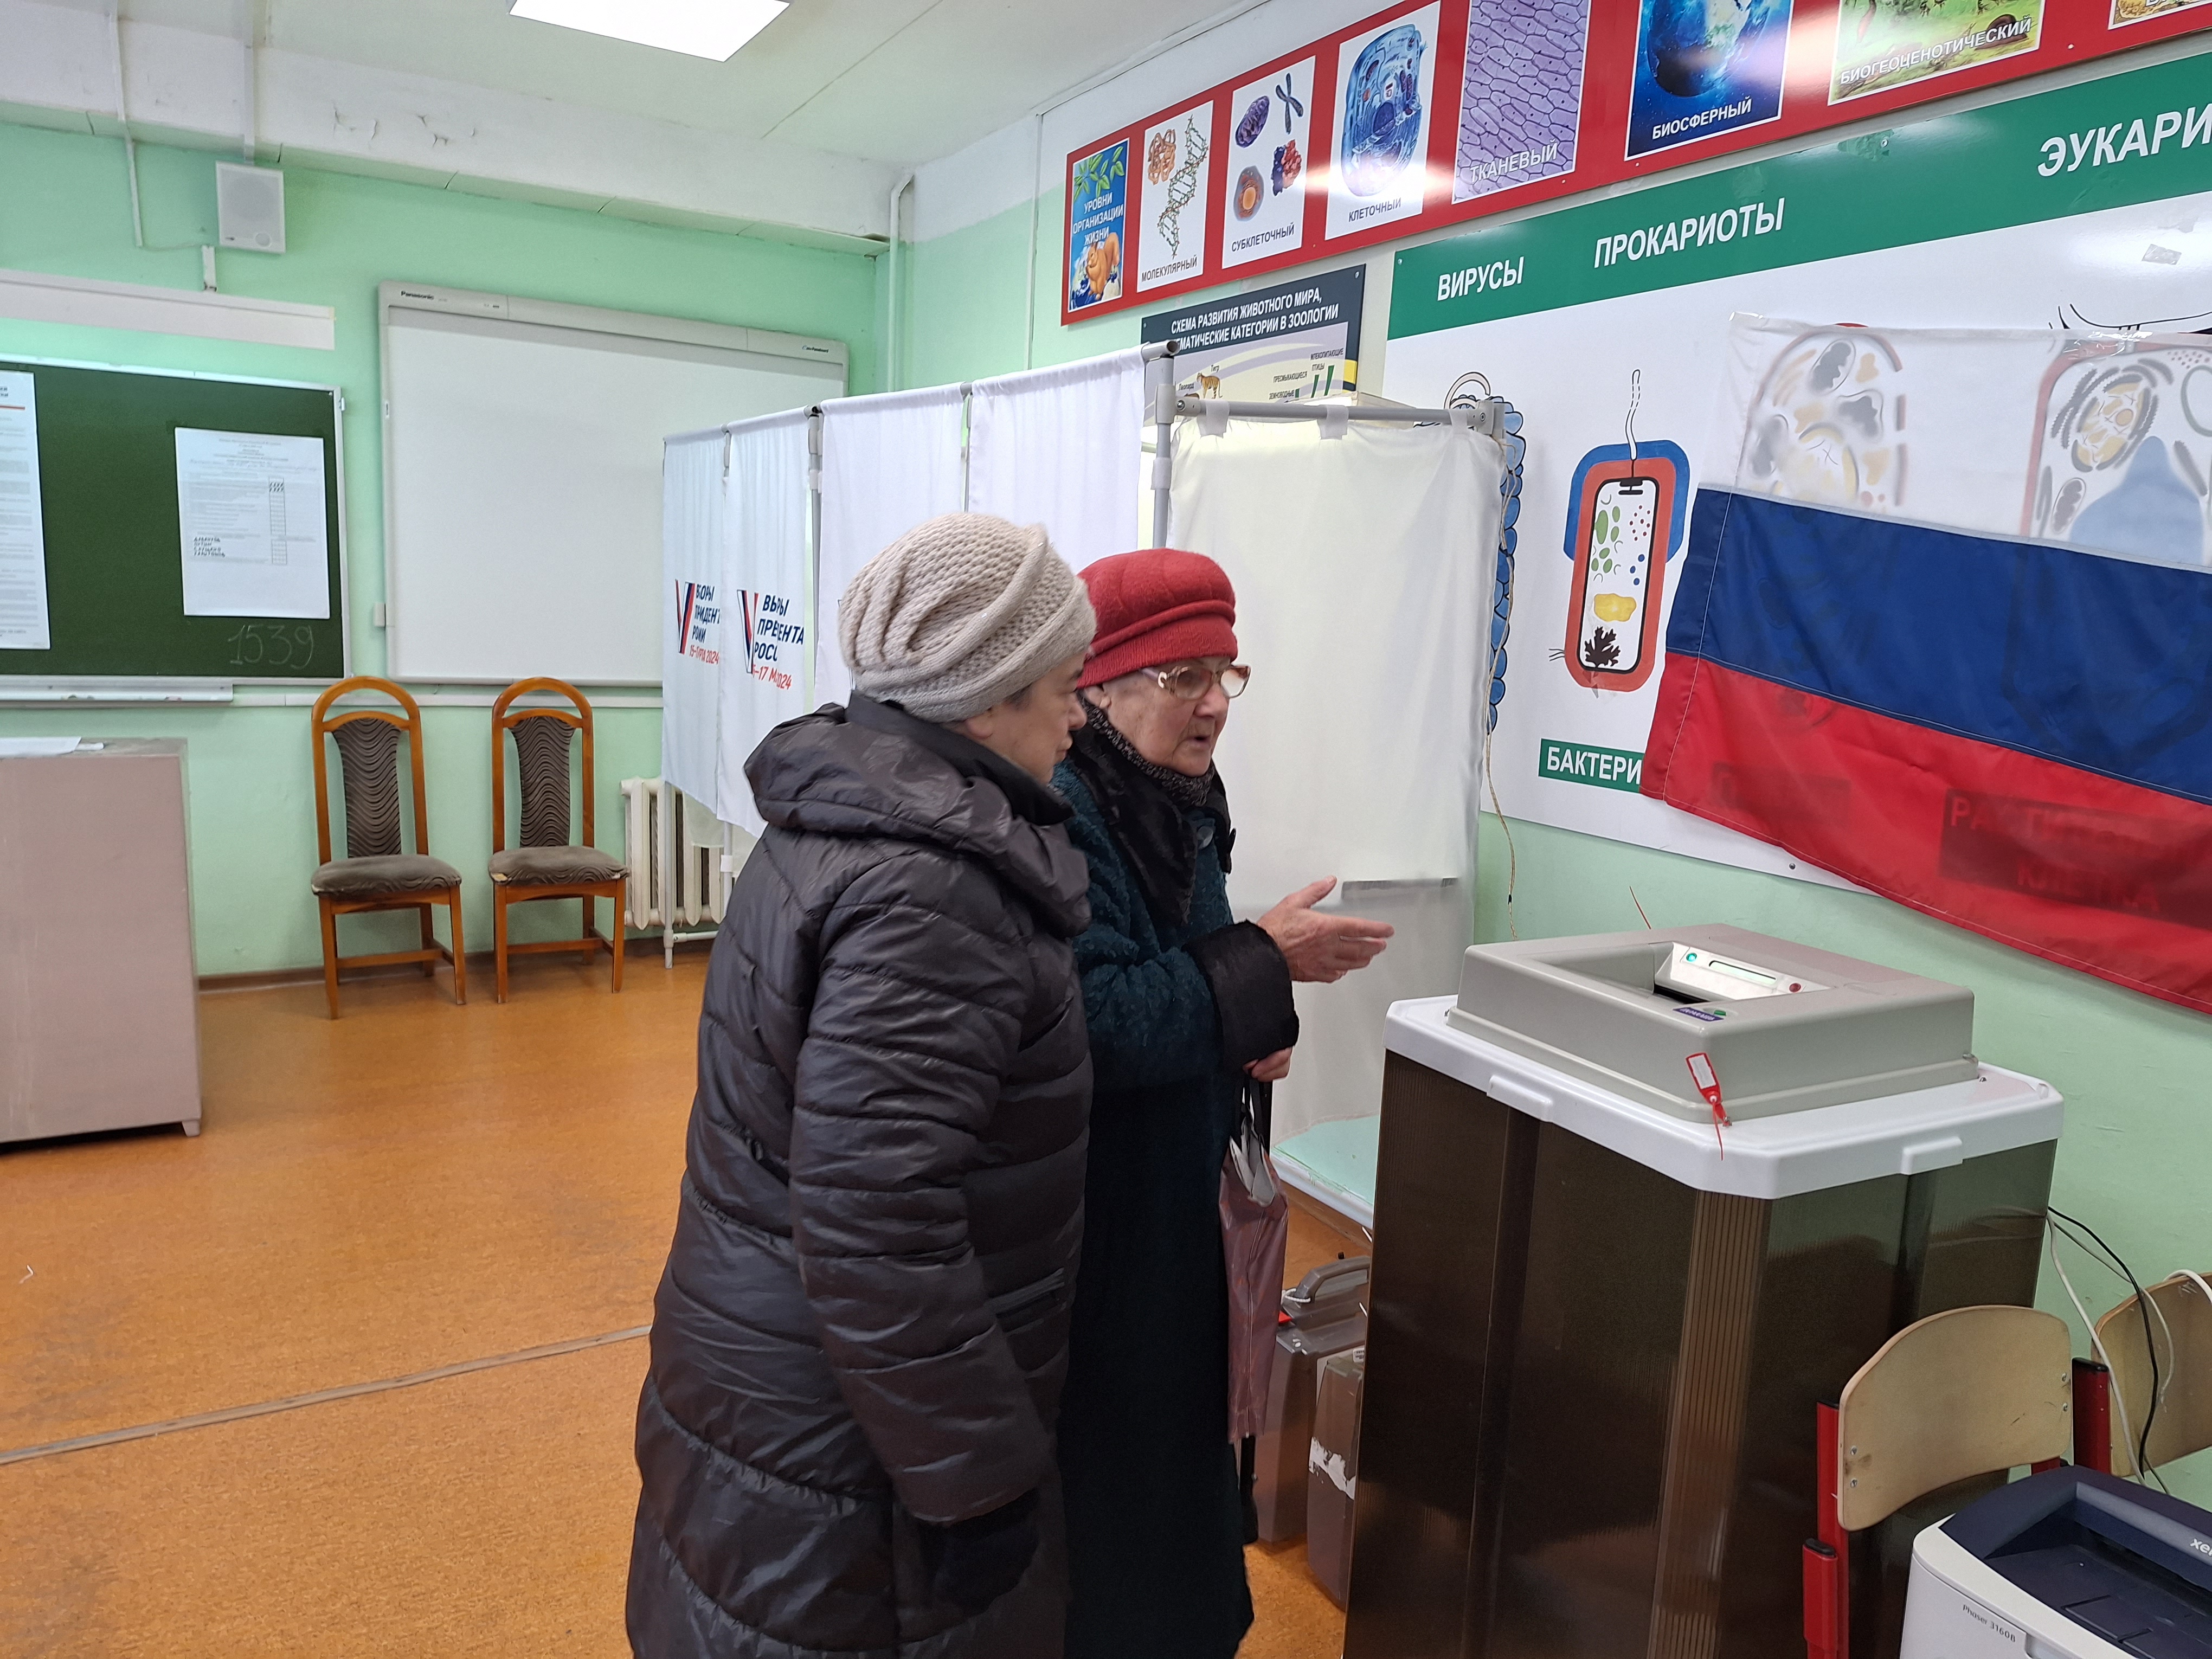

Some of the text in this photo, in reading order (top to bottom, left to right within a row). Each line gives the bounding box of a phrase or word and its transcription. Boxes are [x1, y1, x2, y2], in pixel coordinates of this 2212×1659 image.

[1840, 15, 2032, 85] БИОГЕОЦЕНОТИЧЕСКИЙ
[1651, 96, 1752, 140] БИОСФЕРНЫЙ
[2037, 103, 2212, 177] ЭУКАРИ
[1470, 138, 1558, 184] ТКАНЕВЫЙ
[1073, 204, 1124, 234] ОРГАНИЗАЦИИ
[1084, 192, 1113, 215] УРОВНИ
[1084, 226, 1109, 246] ЖИЗНИ
[1231, 222, 1295, 252] СУБКЛЕТОЧНЫЙ
[1593, 197, 1785, 269] ПРОКАРИОТЫ
[1141, 255, 1198, 282] МОЛЕКУЛЯРНЫЙ
[1437, 256, 1524, 301] ВИРУСЫ
[401, 290, 434, 300] Panasonic
[1171, 287, 1322, 335] СХЕМА РАЗВИТИЯ ЖИВОТНОГО МИРА,
[1230, 317, 1279, 340] КАТЕГОРИИ
[1280, 318, 1287, 330] В
[1288, 304, 1339, 329] ЗООЛОГИИ
[1311, 363, 1325, 371] ПТИЦЫ
[228, 624, 314, 670] 1539
[706, 650, 719, 665] 2024
[1546, 746, 1642, 785] БАКТЕРИ
[1963, 1604, 2016, 1642] Phaser 3160B
